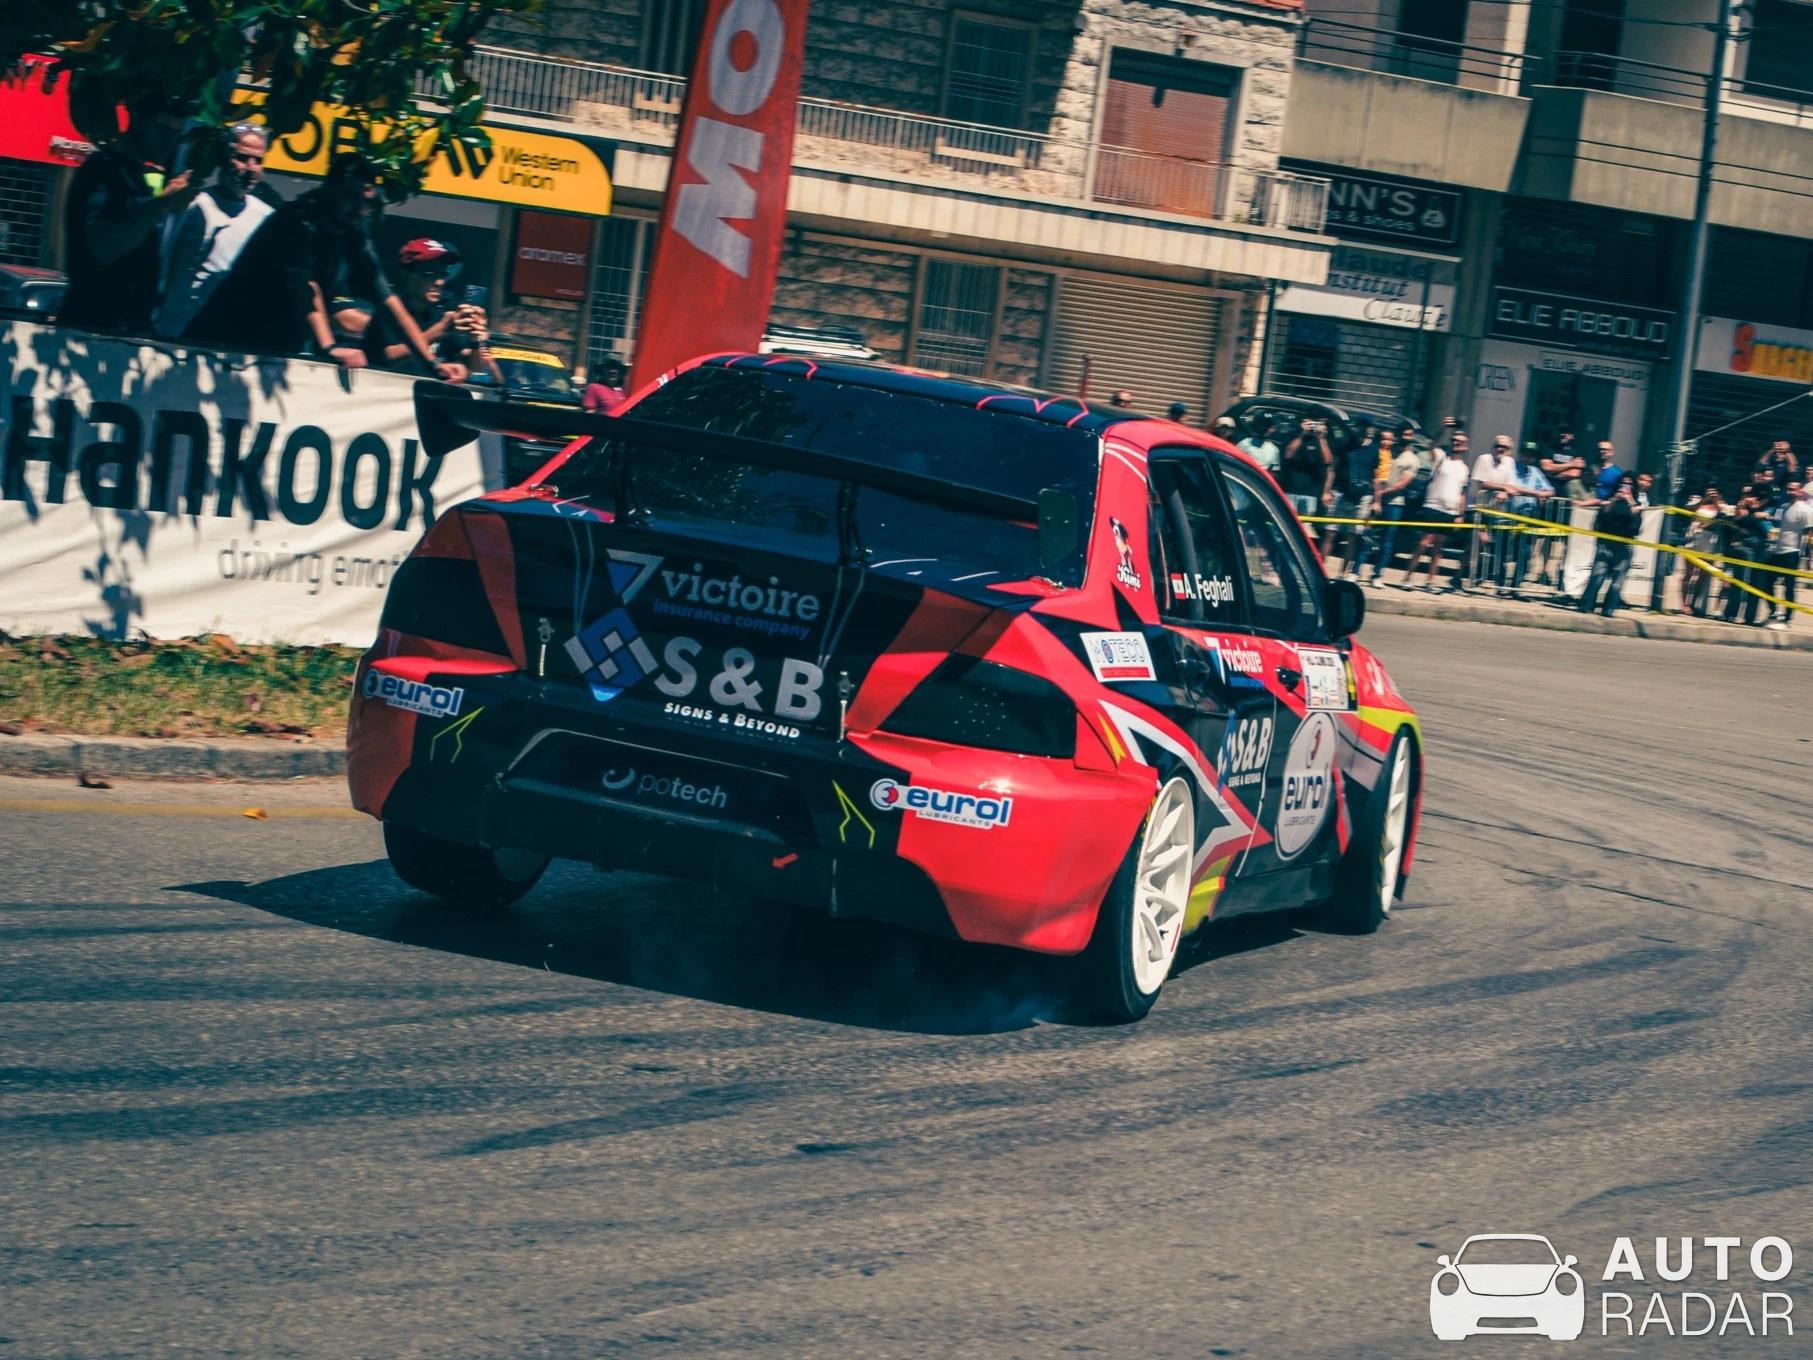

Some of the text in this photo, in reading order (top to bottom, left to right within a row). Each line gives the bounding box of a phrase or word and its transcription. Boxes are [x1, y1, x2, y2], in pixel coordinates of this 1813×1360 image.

[498, 164, 556, 191] Union
[502, 146, 579, 175] Western
[1496, 299, 1669, 343] ELIE ABBOUD
[3, 394, 446, 531] Hankook
[219, 539, 323, 595] driving
[661, 563, 820, 621] victoire
[1184, 573, 1234, 608] A. Feghali
[734, 614, 811, 641] company
[1221, 638, 1263, 673] victoire
[380, 676, 460, 713] eurol
[654, 636, 824, 721] S & B
[718, 712, 729, 724] &
[637, 773, 728, 809] potech
[906, 785, 1011, 824] eurol
[1284, 763, 1329, 811] eurol
[918, 809, 990, 828] LUBRICANTS
